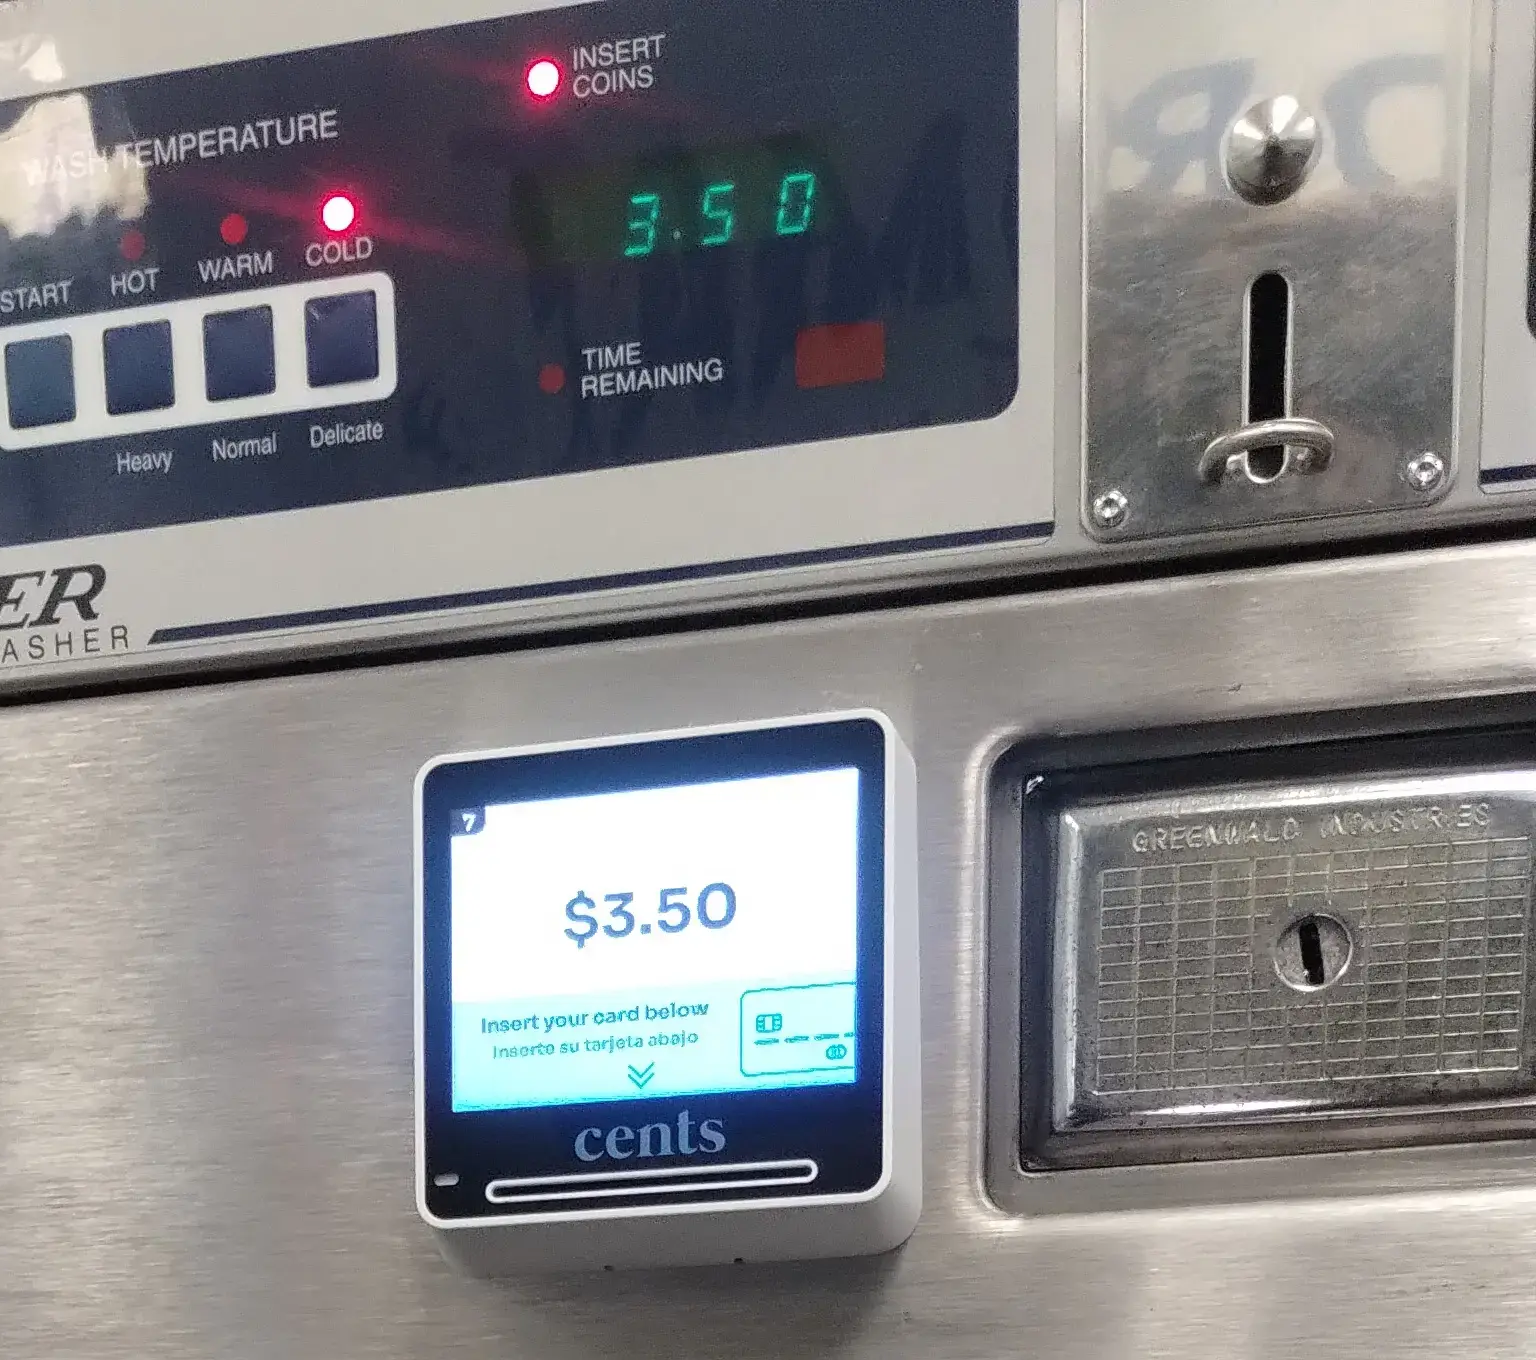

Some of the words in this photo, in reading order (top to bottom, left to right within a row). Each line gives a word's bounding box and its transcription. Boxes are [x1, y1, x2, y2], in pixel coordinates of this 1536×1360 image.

[573, 34, 665, 70] INSERT
[573, 65, 654, 98] COINS
[21, 145, 108, 184] WASH
[119, 109, 339, 168] TEMPERATURE
[624, 173, 815, 256] 3.50
[198, 251, 273, 282] WARM
[305, 236, 373, 267] COLD
[0, 281, 72, 313] START
[111, 268, 159, 296] HOT
[581, 342, 642, 371] TIME
[581, 358, 723, 399] REMAINING
[213, 433, 277, 461] Normal
[310, 420, 384, 448] Delicate
[117, 452, 172, 473] Heavy
[462, 812, 476, 831] 7
[564, 882, 737, 948] $3.50
[481, 1014, 539, 1033] Insert
[544, 1011, 588, 1033] your
[594, 1006, 639, 1025] card
[645, 1002, 709, 1020] below
[560, 1041, 579, 1053] su
[584, 1035, 643, 1053] tarjeta
[648, 1031, 699, 1047] abajo
[574, 1110, 727, 1162] cents
